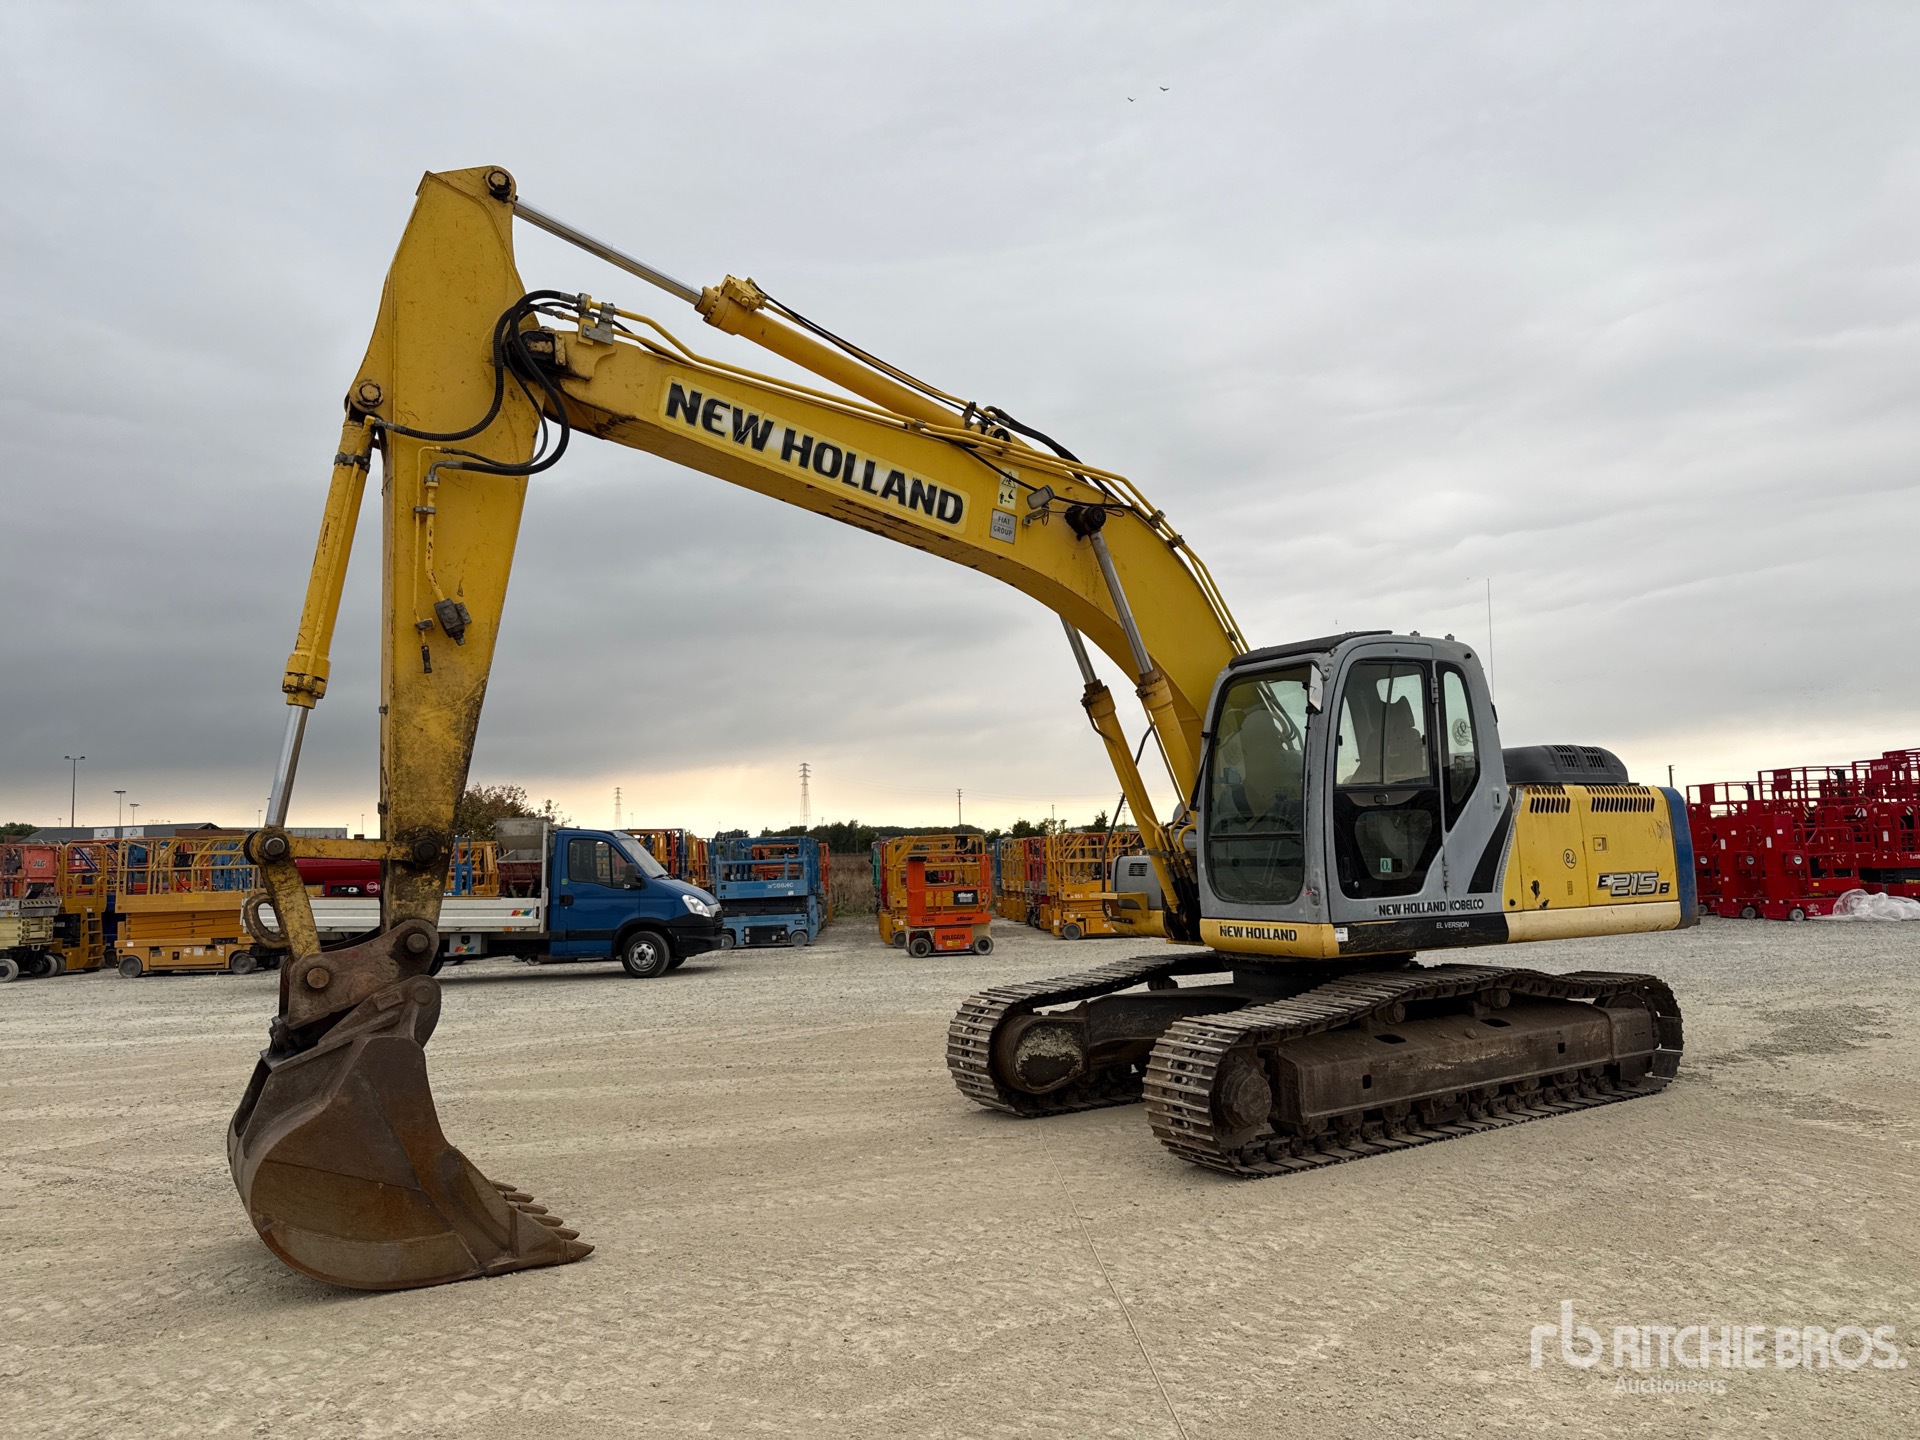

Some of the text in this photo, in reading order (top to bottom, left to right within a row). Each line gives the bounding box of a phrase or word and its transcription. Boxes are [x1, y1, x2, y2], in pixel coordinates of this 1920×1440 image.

[665, 381, 964, 526] NEW HOLLAND
[998, 515, 1010, 524] FIAT
[993, 525, 1013, 536] GROUP
[33, 860, 46, 868] JLG
[1379, 899, 1485, 916] NEW HOLLAND KOBELCO
[1220, 925, 1298, 941] NEW HOLLAND
